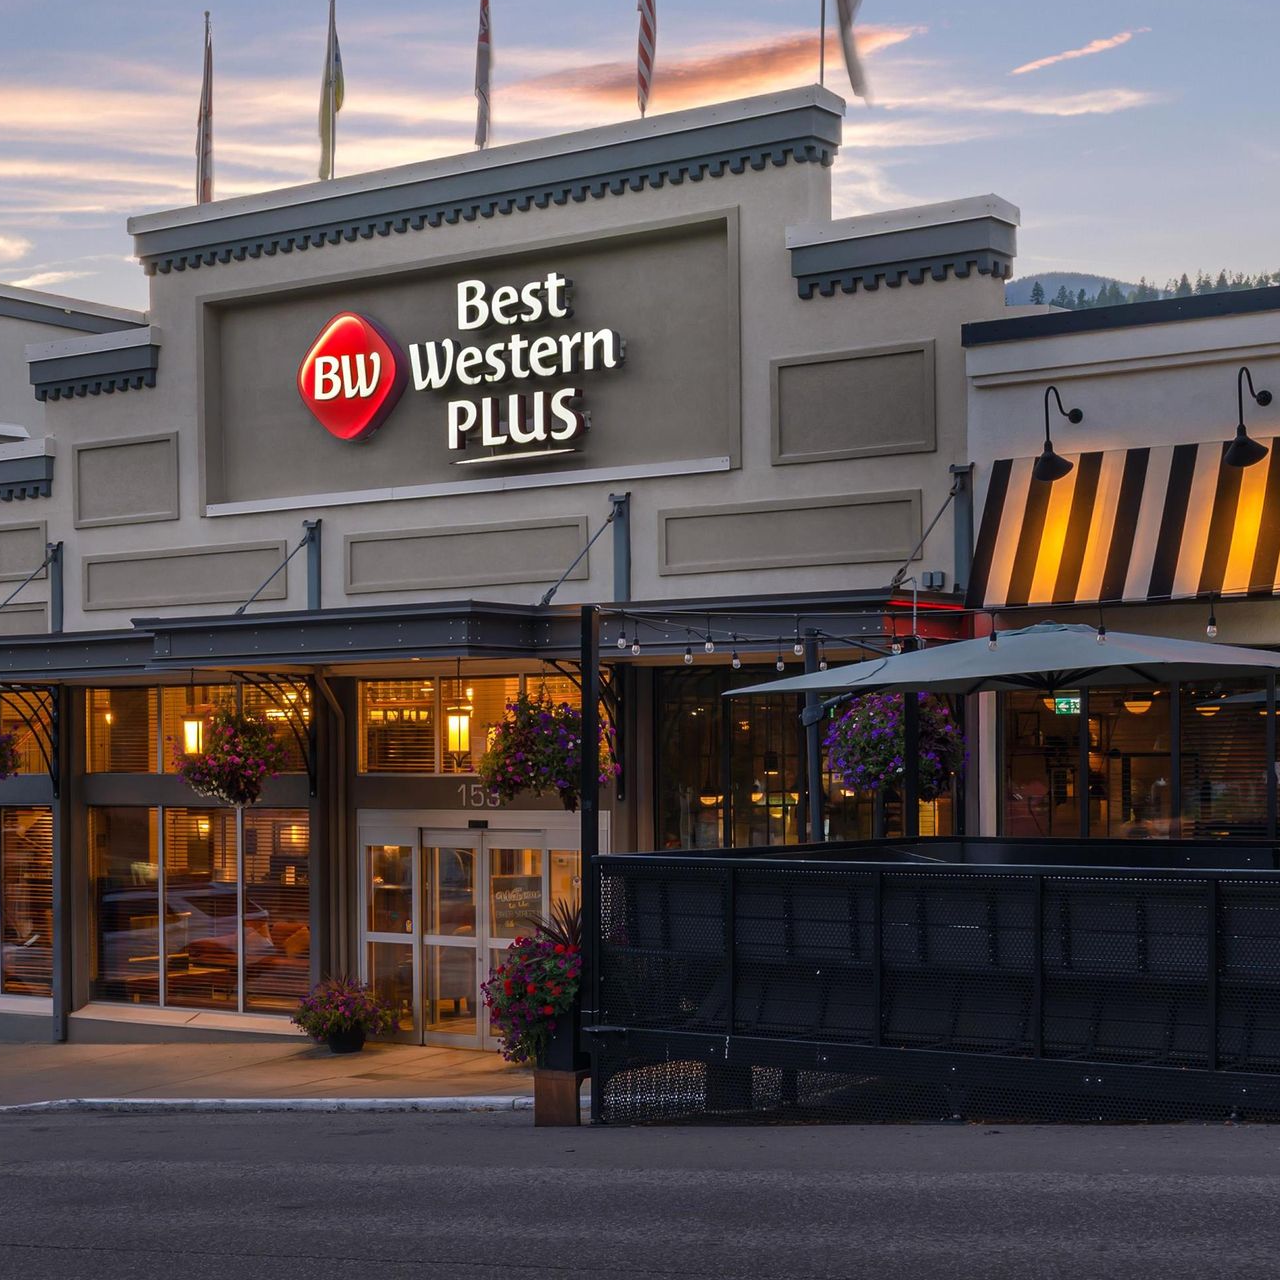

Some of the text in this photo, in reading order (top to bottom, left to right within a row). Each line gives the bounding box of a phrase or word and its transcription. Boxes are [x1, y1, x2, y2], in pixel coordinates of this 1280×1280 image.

[457, 272, 568, 330] Best
[314, 351, 381, 400] BW
[408, 328, 617, 391] Western
[447, 387, 577, 449] PLUS
[458, 784, 500, 807] 153
